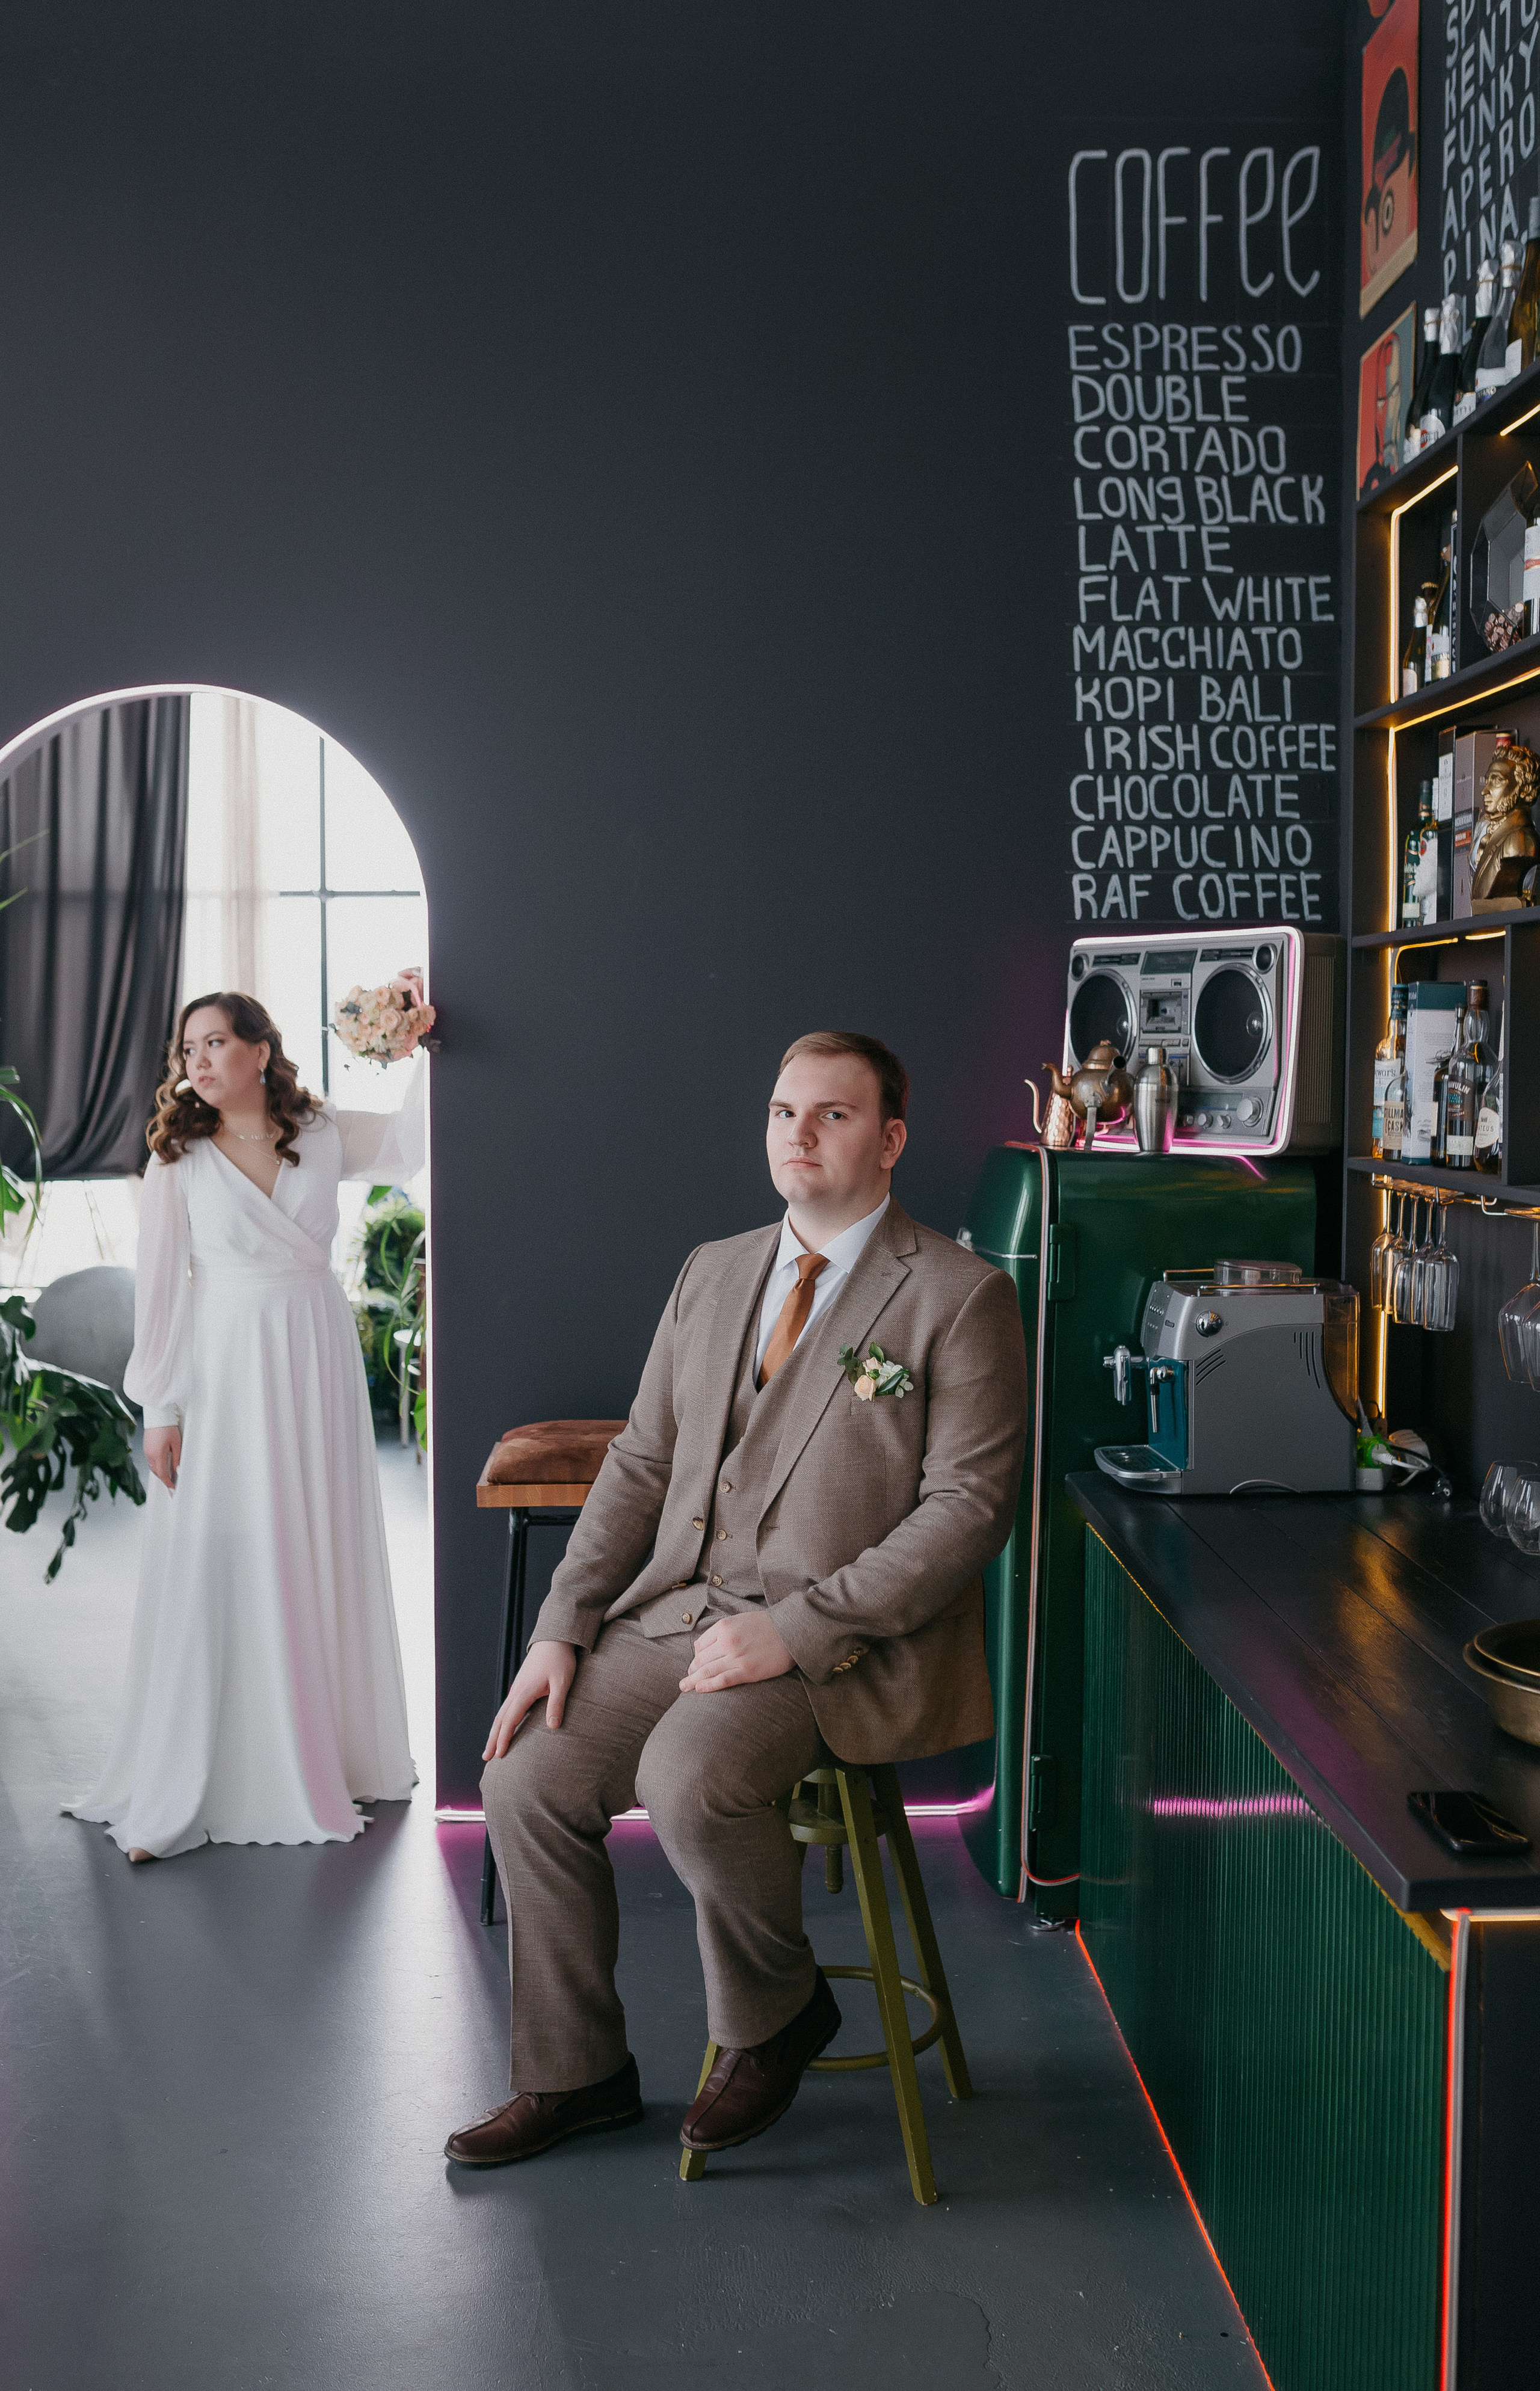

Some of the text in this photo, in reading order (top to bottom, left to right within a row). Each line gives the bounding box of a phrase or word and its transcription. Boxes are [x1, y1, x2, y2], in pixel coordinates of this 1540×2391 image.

[1068, 323, 1301, 371] ESPRESSO
[1072, 374, 1248, 423] DOUBLE
[1074, 425, 1286, 476] CORTADO
[1195, 475, 1325, 524] BLACK
[1079, 525, 1233, 573] LATTE
[1079, 575, 1334, 623] FLAT WHITE
[1073, 625, 1302, 671] MACCHIATO
[1075, 675, 1291, 722] KOPI BALI
[1085, 724, 1335, 771] IRISH COFFEE
[1070, 774, 1299, 820] CHOCOLATE
[1071, 825, 1311, 870] CAPPUCINO
[1071, 872, 1321, 920] RAF COFFEE
